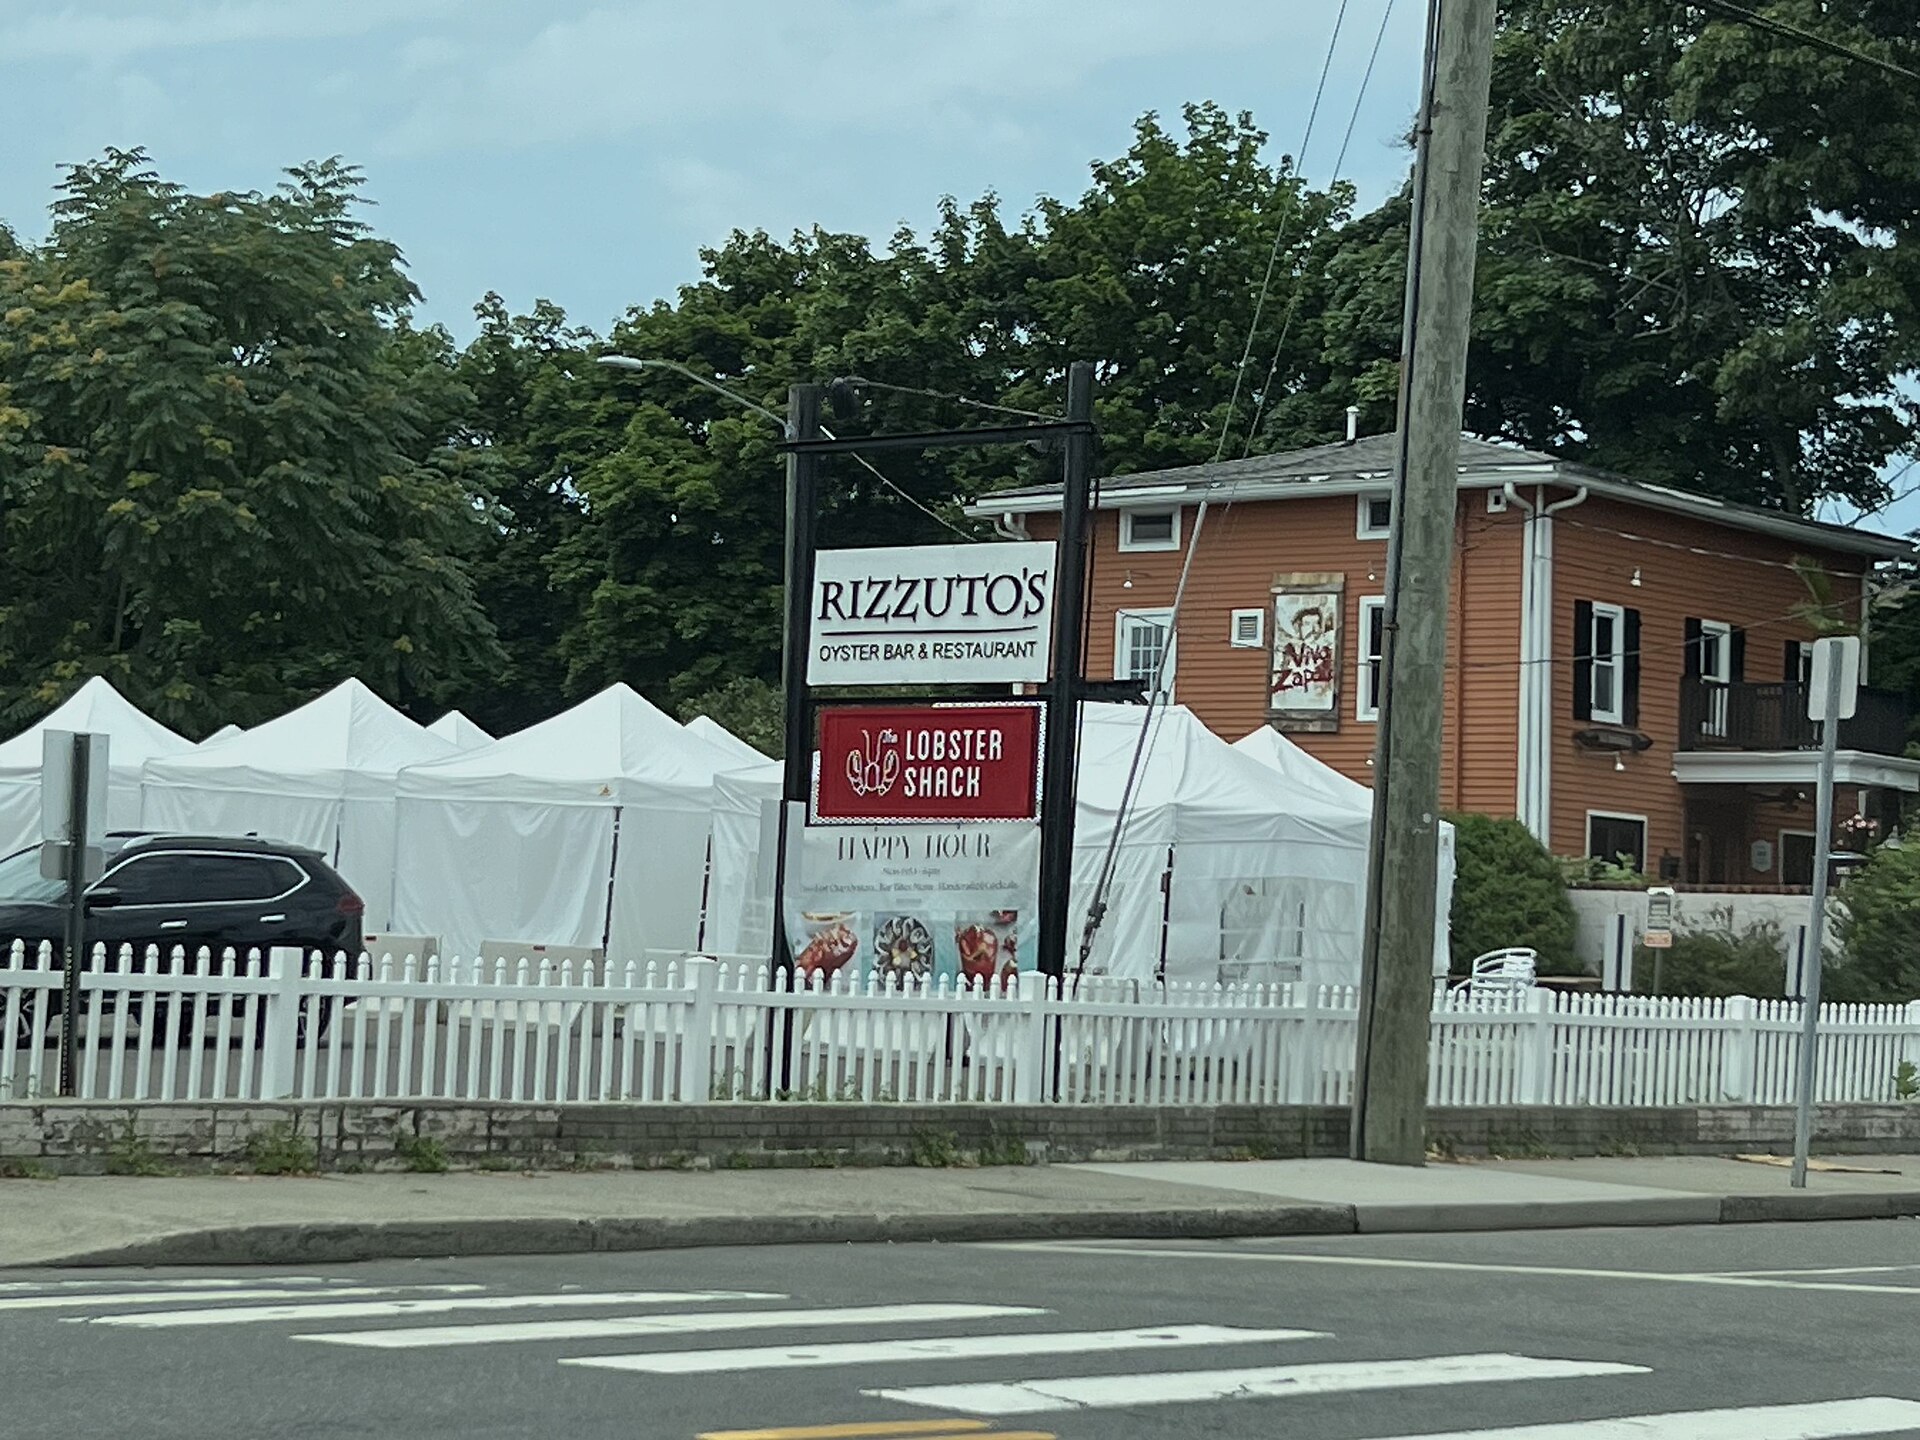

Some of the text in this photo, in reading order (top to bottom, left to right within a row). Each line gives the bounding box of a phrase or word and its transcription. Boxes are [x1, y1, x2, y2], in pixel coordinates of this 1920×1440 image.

[817, 567, 1047, 623] RIZZUTO'S
[819, 640, 1037, 662] OYSTER BAR & RESTAURANT
[905, 729, 1002, 761] LOBSTER
[904, 766, 980, 797] SHACK
[838, 833, 991, 860] HAPPY HOUR
